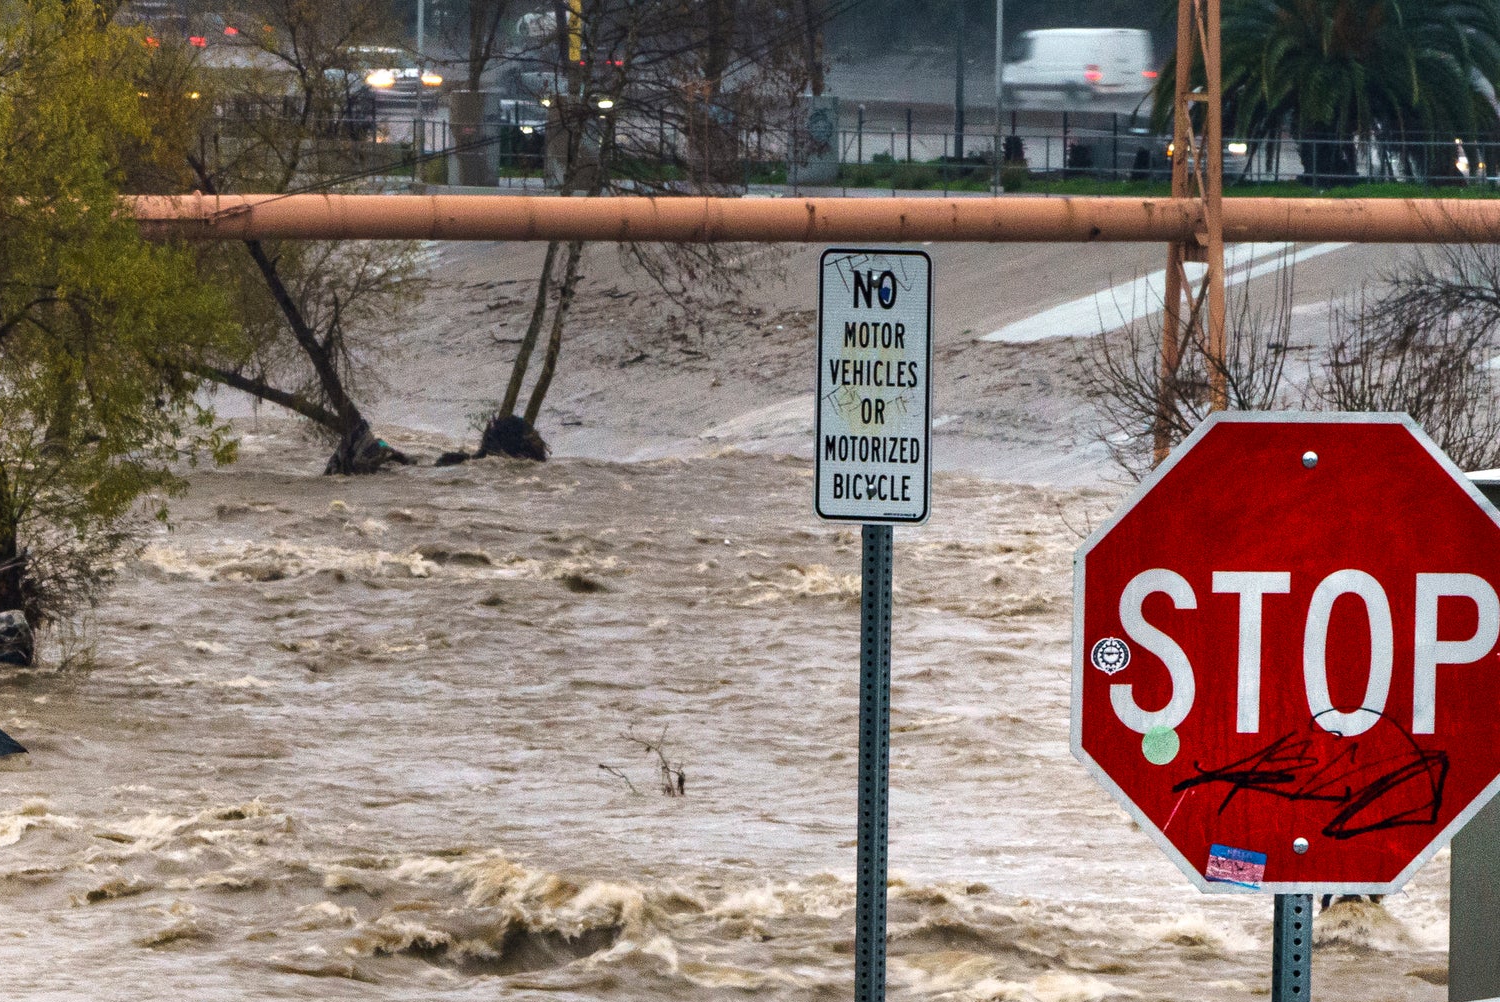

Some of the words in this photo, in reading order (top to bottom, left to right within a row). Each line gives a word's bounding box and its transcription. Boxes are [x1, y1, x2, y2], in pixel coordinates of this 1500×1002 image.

[853, 270, 897, 310] NO
[844, 321, 905, 349] MOTOR
[829, 359, 918, 388] VEHICLES
[861, 398, 885, 424] OR
[825, 435, 920, 464] MOTORIZED
[833, 473, 911, 501] BICYCLE
[1109, 568, 1500, 737] STOP
